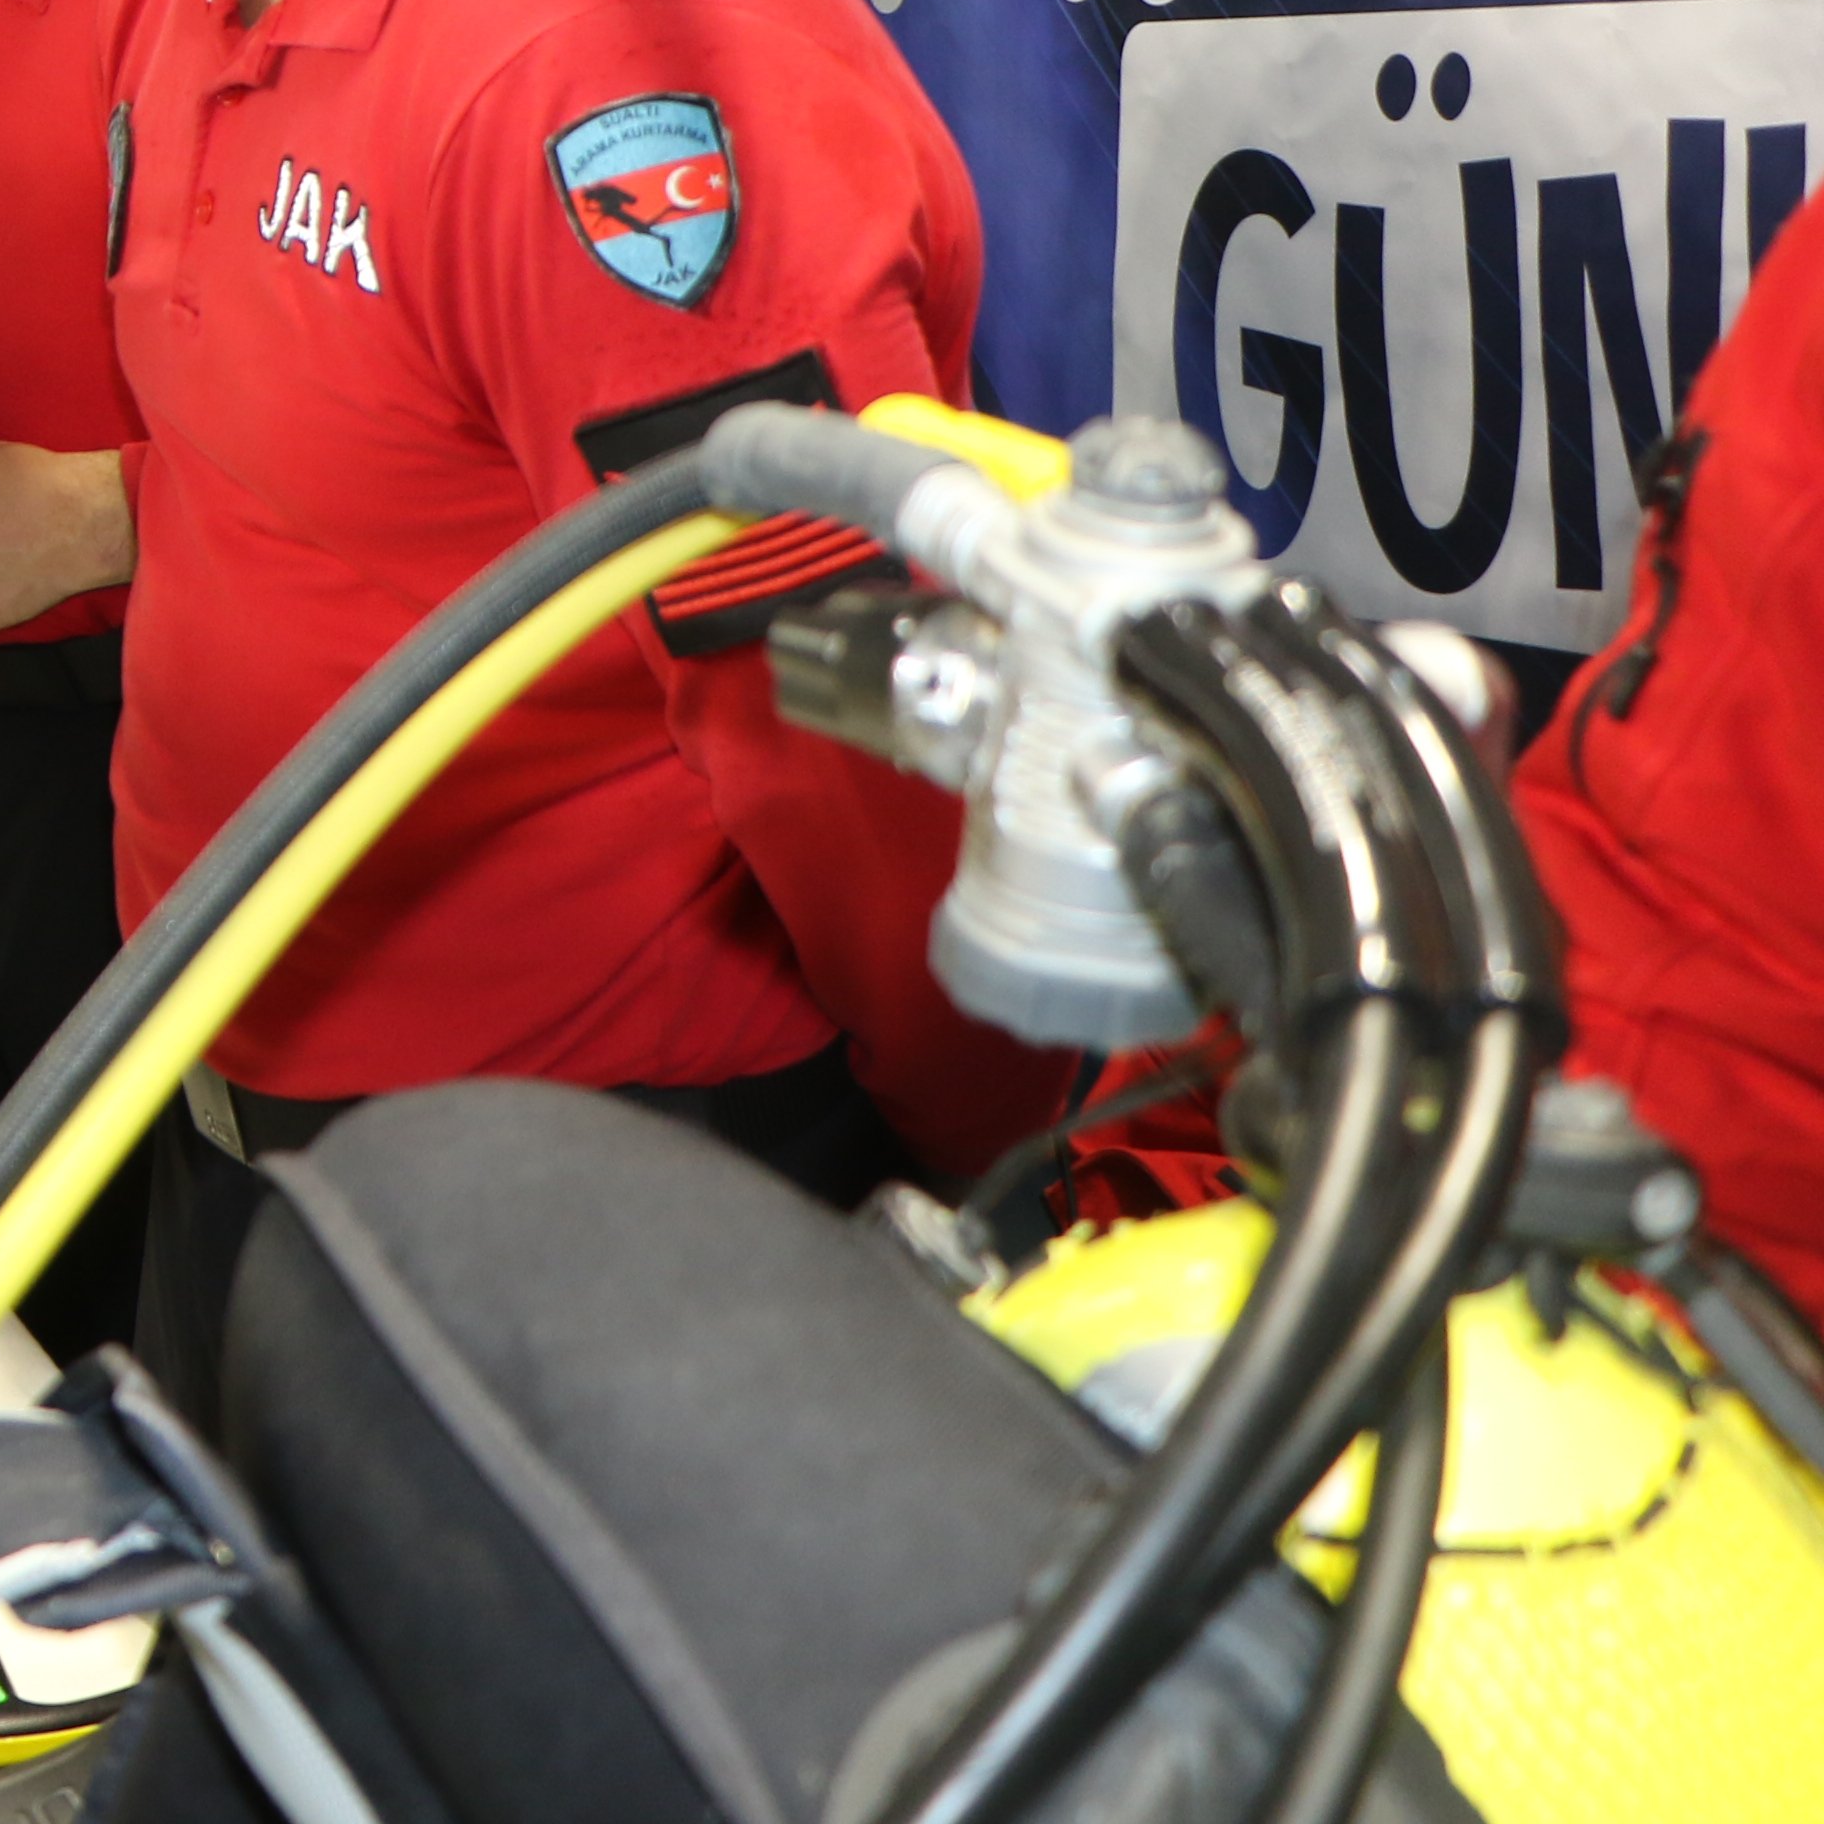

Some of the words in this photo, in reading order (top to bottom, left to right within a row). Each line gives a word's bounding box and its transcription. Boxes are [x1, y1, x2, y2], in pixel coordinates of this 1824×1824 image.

[600, 104, 660, 130] SUALTI
[621, 124, 709, 146] KURTARMA
[258, 155, 381, 294] JAK
[654, 264, 698, 286] JAK
[1172, 51, 1806, 595] GÜN
